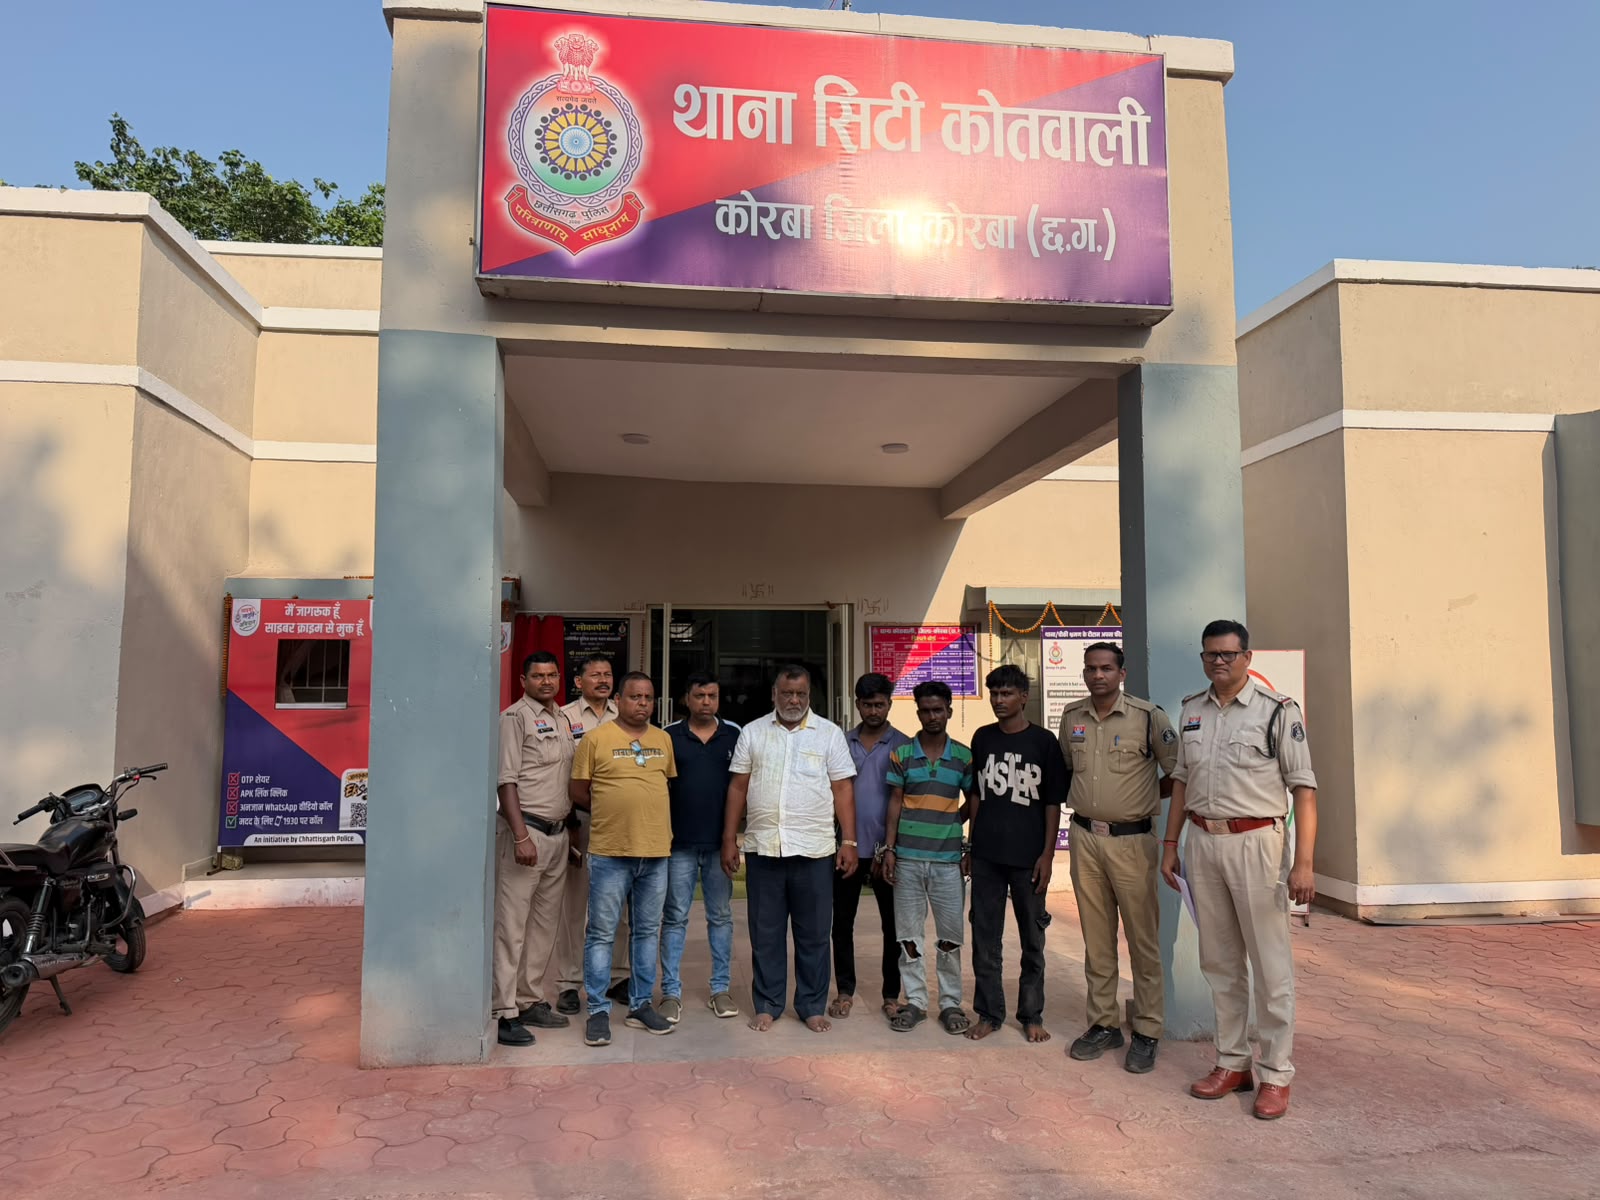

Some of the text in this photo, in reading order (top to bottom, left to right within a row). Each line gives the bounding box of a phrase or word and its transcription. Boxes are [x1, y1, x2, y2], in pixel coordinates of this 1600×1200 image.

[556, 95, 597, 104] सत्यमेव जयते
[673, 74, 1151, 167] थाना सिटी कोतवाली
[581, 205, 610, 221] पुलिस
[514, 204, 569, 242] परित्राणाय
[715, 190, 814, 240] कोरबा
[922, 203, 1017, 251] कोरबा
[1027, 203, 1117, 261] (छ.ग.)
[284, 603, 296, 617] मैं
[332, 601, 341, 620] हूँ
[264, 622, 296, 634] साइबर
[296, 622, 324, 634] क्राइम
[325, 620, 335, 634] से
[356, 618, 365, 636] हूँ
[241, 773, 270, 784] OTP शेयर
[240, 789, 254, 797] APK
[254, 787, 269, 798] लिंक
[240, 804, 263, 812] अनजान
[298, 800, 318, 811] वीडियो
[318, 801, 333, 811] कॉल
[238, 815, 323, 826] मदद के लिए 1930 पर कॉल
[263, 835, 290, 843] initiative
[290, 835, 297, 844] by
[298, 835, 335, 844] Chhattisgarh
